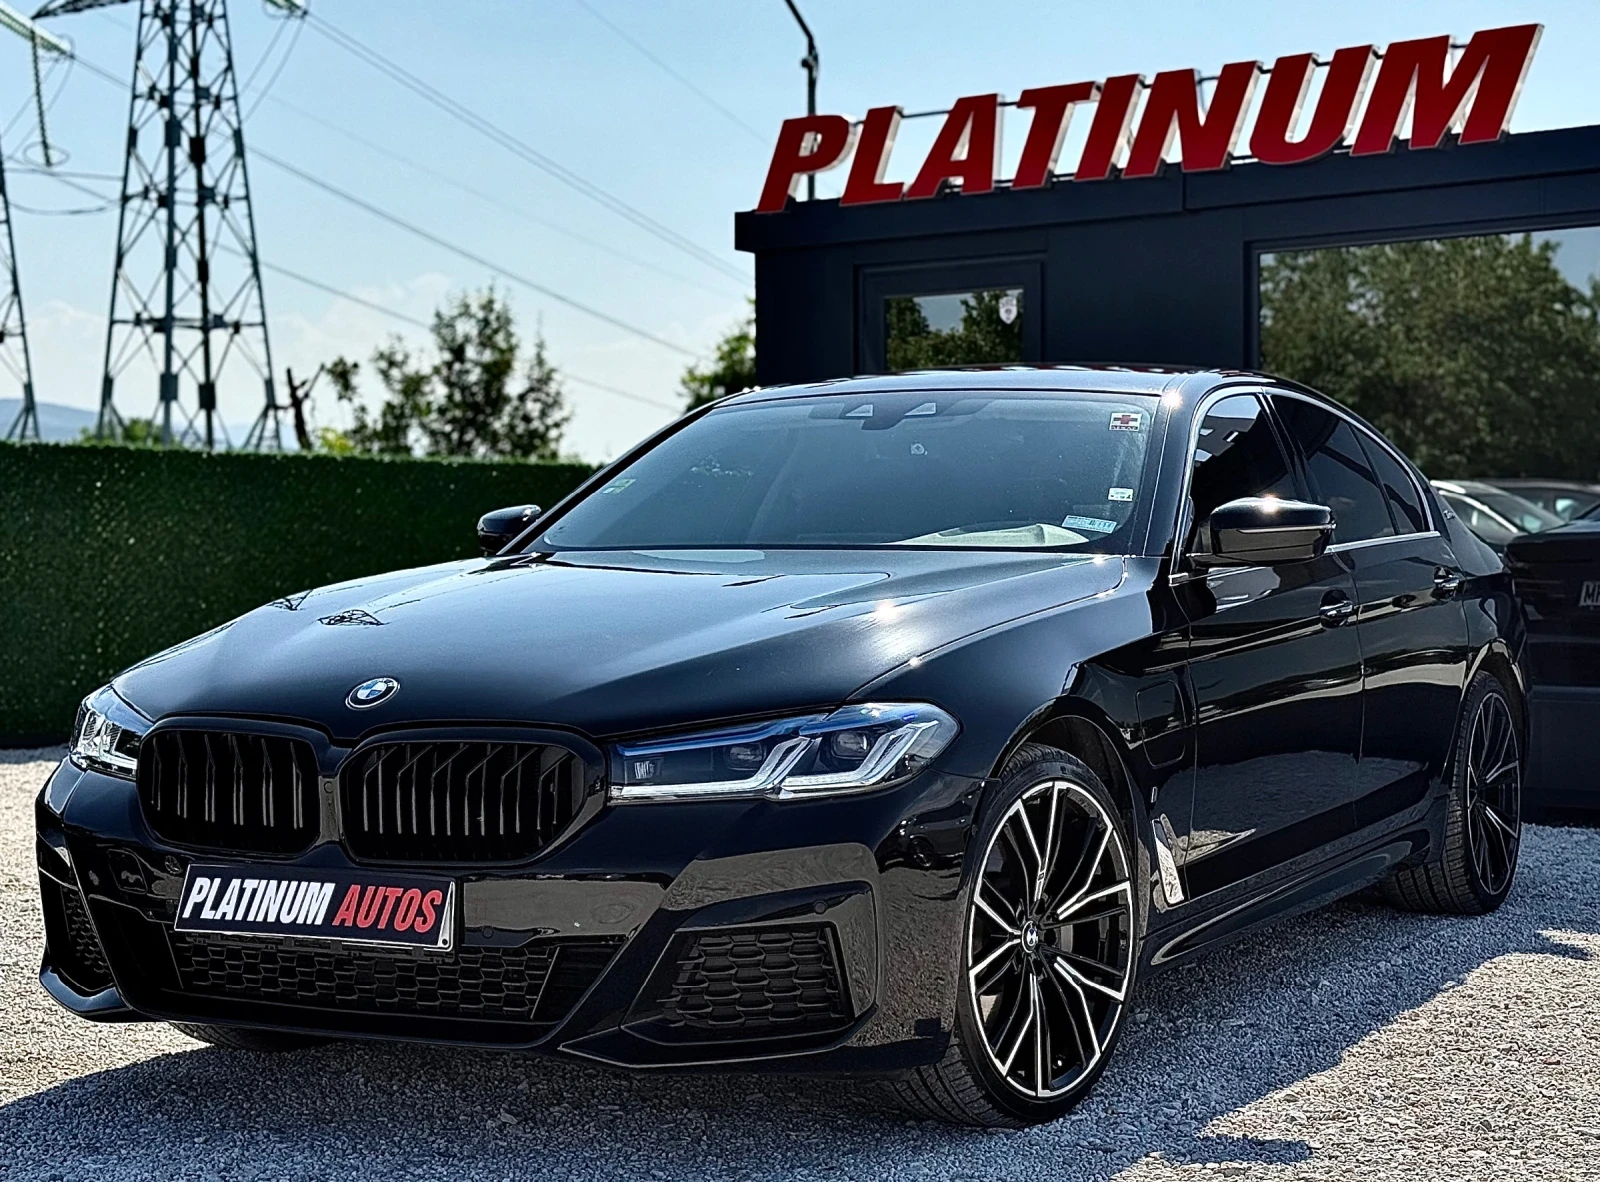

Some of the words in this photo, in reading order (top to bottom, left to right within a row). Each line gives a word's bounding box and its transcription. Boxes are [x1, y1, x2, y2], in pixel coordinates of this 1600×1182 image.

[755, 23, 1542, 214] PLATINUM
[181, 876, 336, 926] PLATINUM
[332, 884, 443, 933] AUTOS
